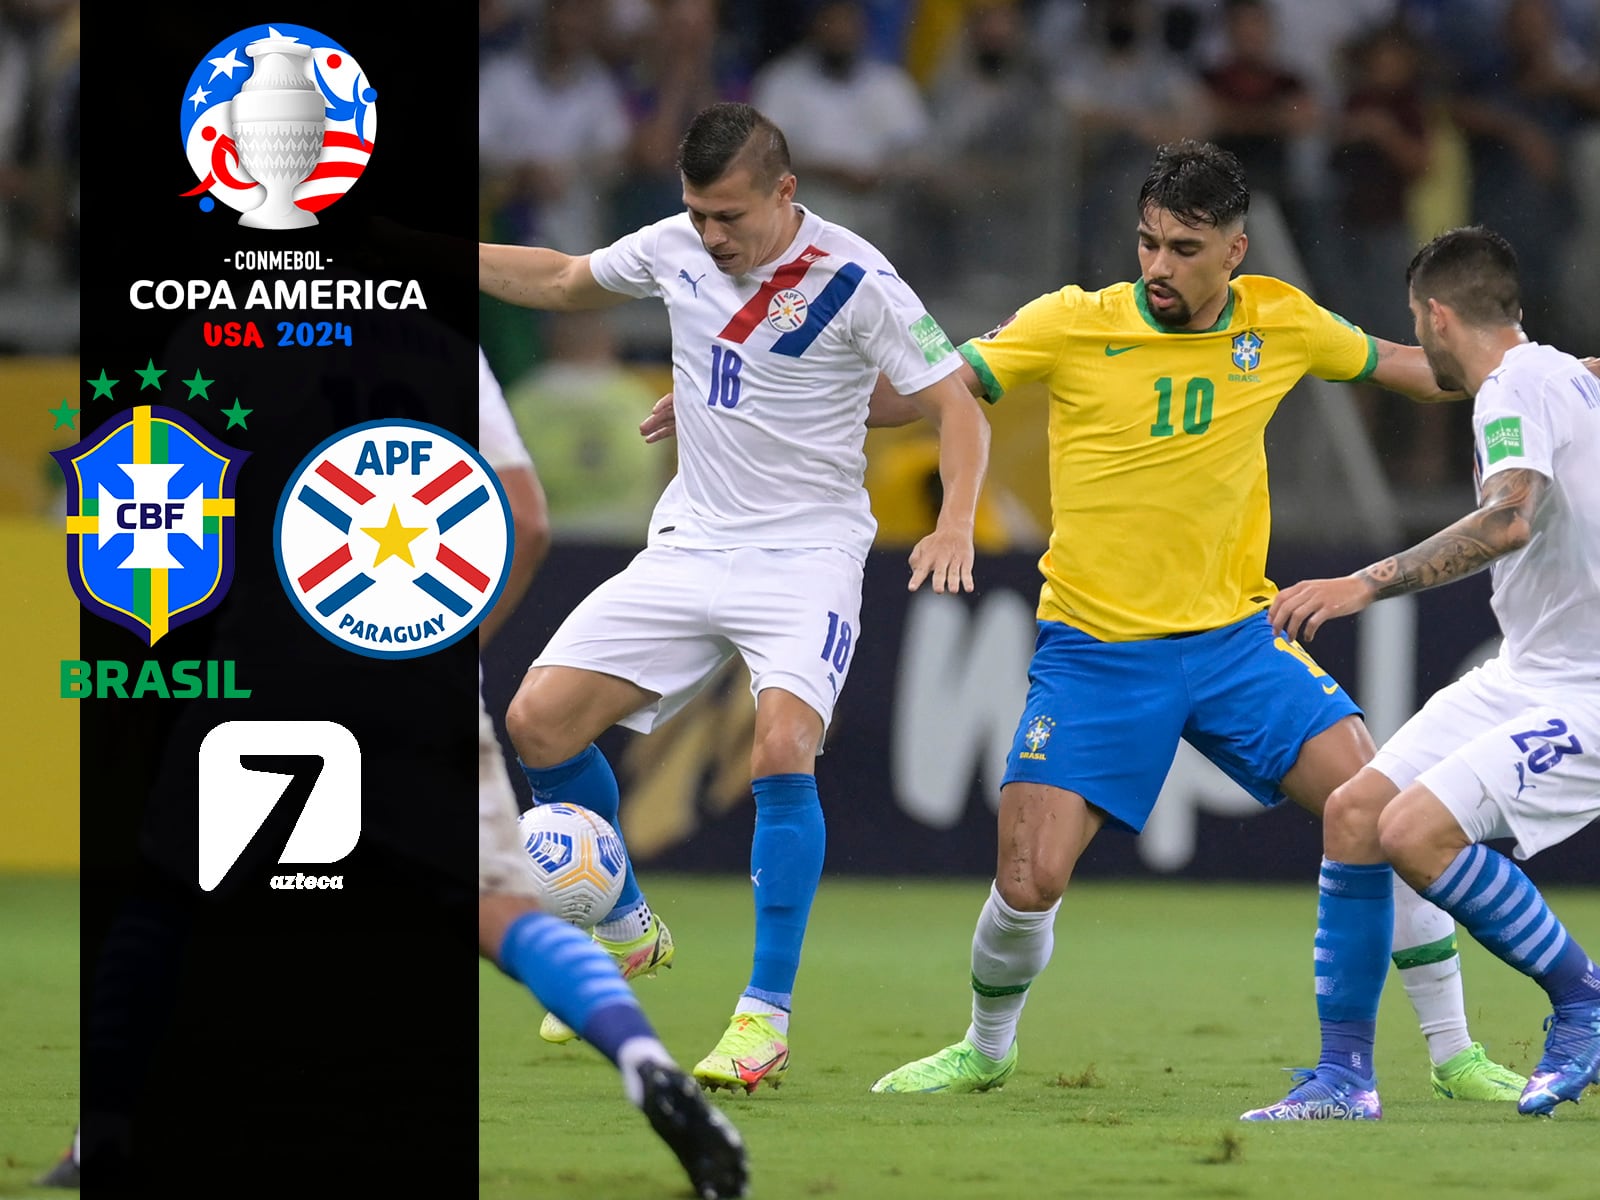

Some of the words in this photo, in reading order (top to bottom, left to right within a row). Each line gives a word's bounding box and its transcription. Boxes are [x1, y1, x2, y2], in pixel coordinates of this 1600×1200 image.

[707, 344, 743, 409] 18
[1150, 376, 1214, 437] 10
[820, 610, 852, 674] 18
[1510, 718, 1584, 774] 23
